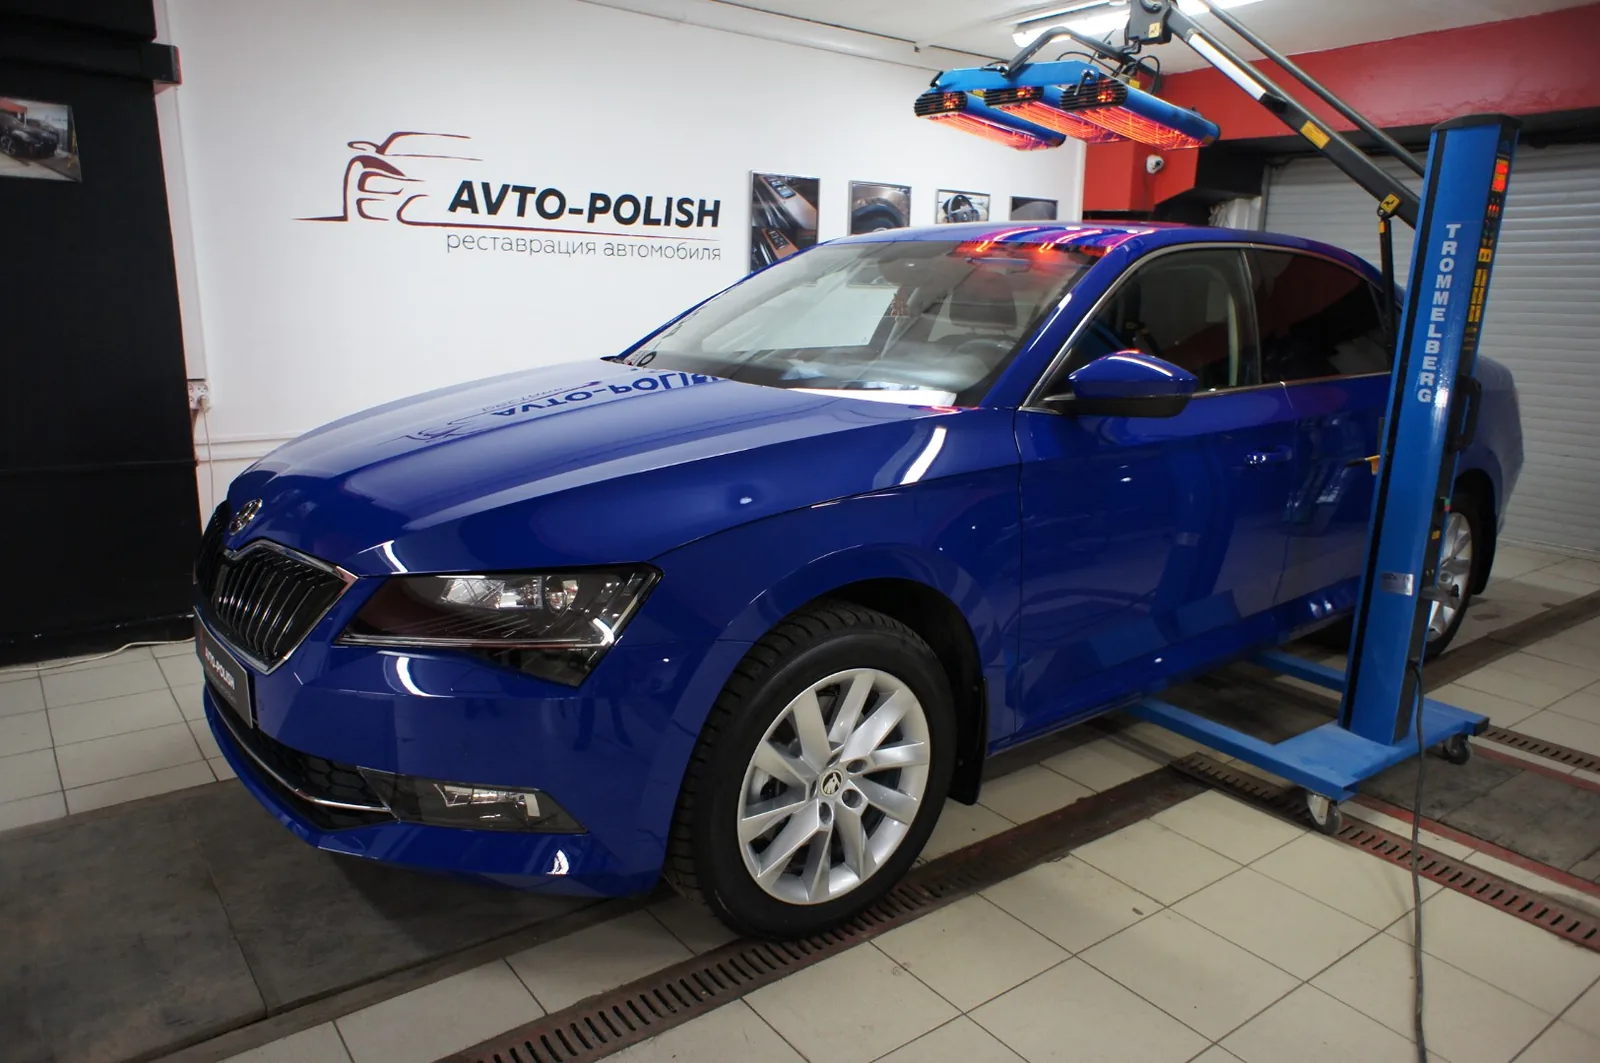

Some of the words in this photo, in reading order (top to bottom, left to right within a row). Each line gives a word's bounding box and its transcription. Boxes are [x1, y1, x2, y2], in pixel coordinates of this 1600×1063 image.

[447, 180, 720, 227] AVTO-POLISH
[446, 234, 596, 256] реставрация
[603, 240, 721, 260] автомобиля
[1418, 223, 1461, 402] TROMMELBERG
